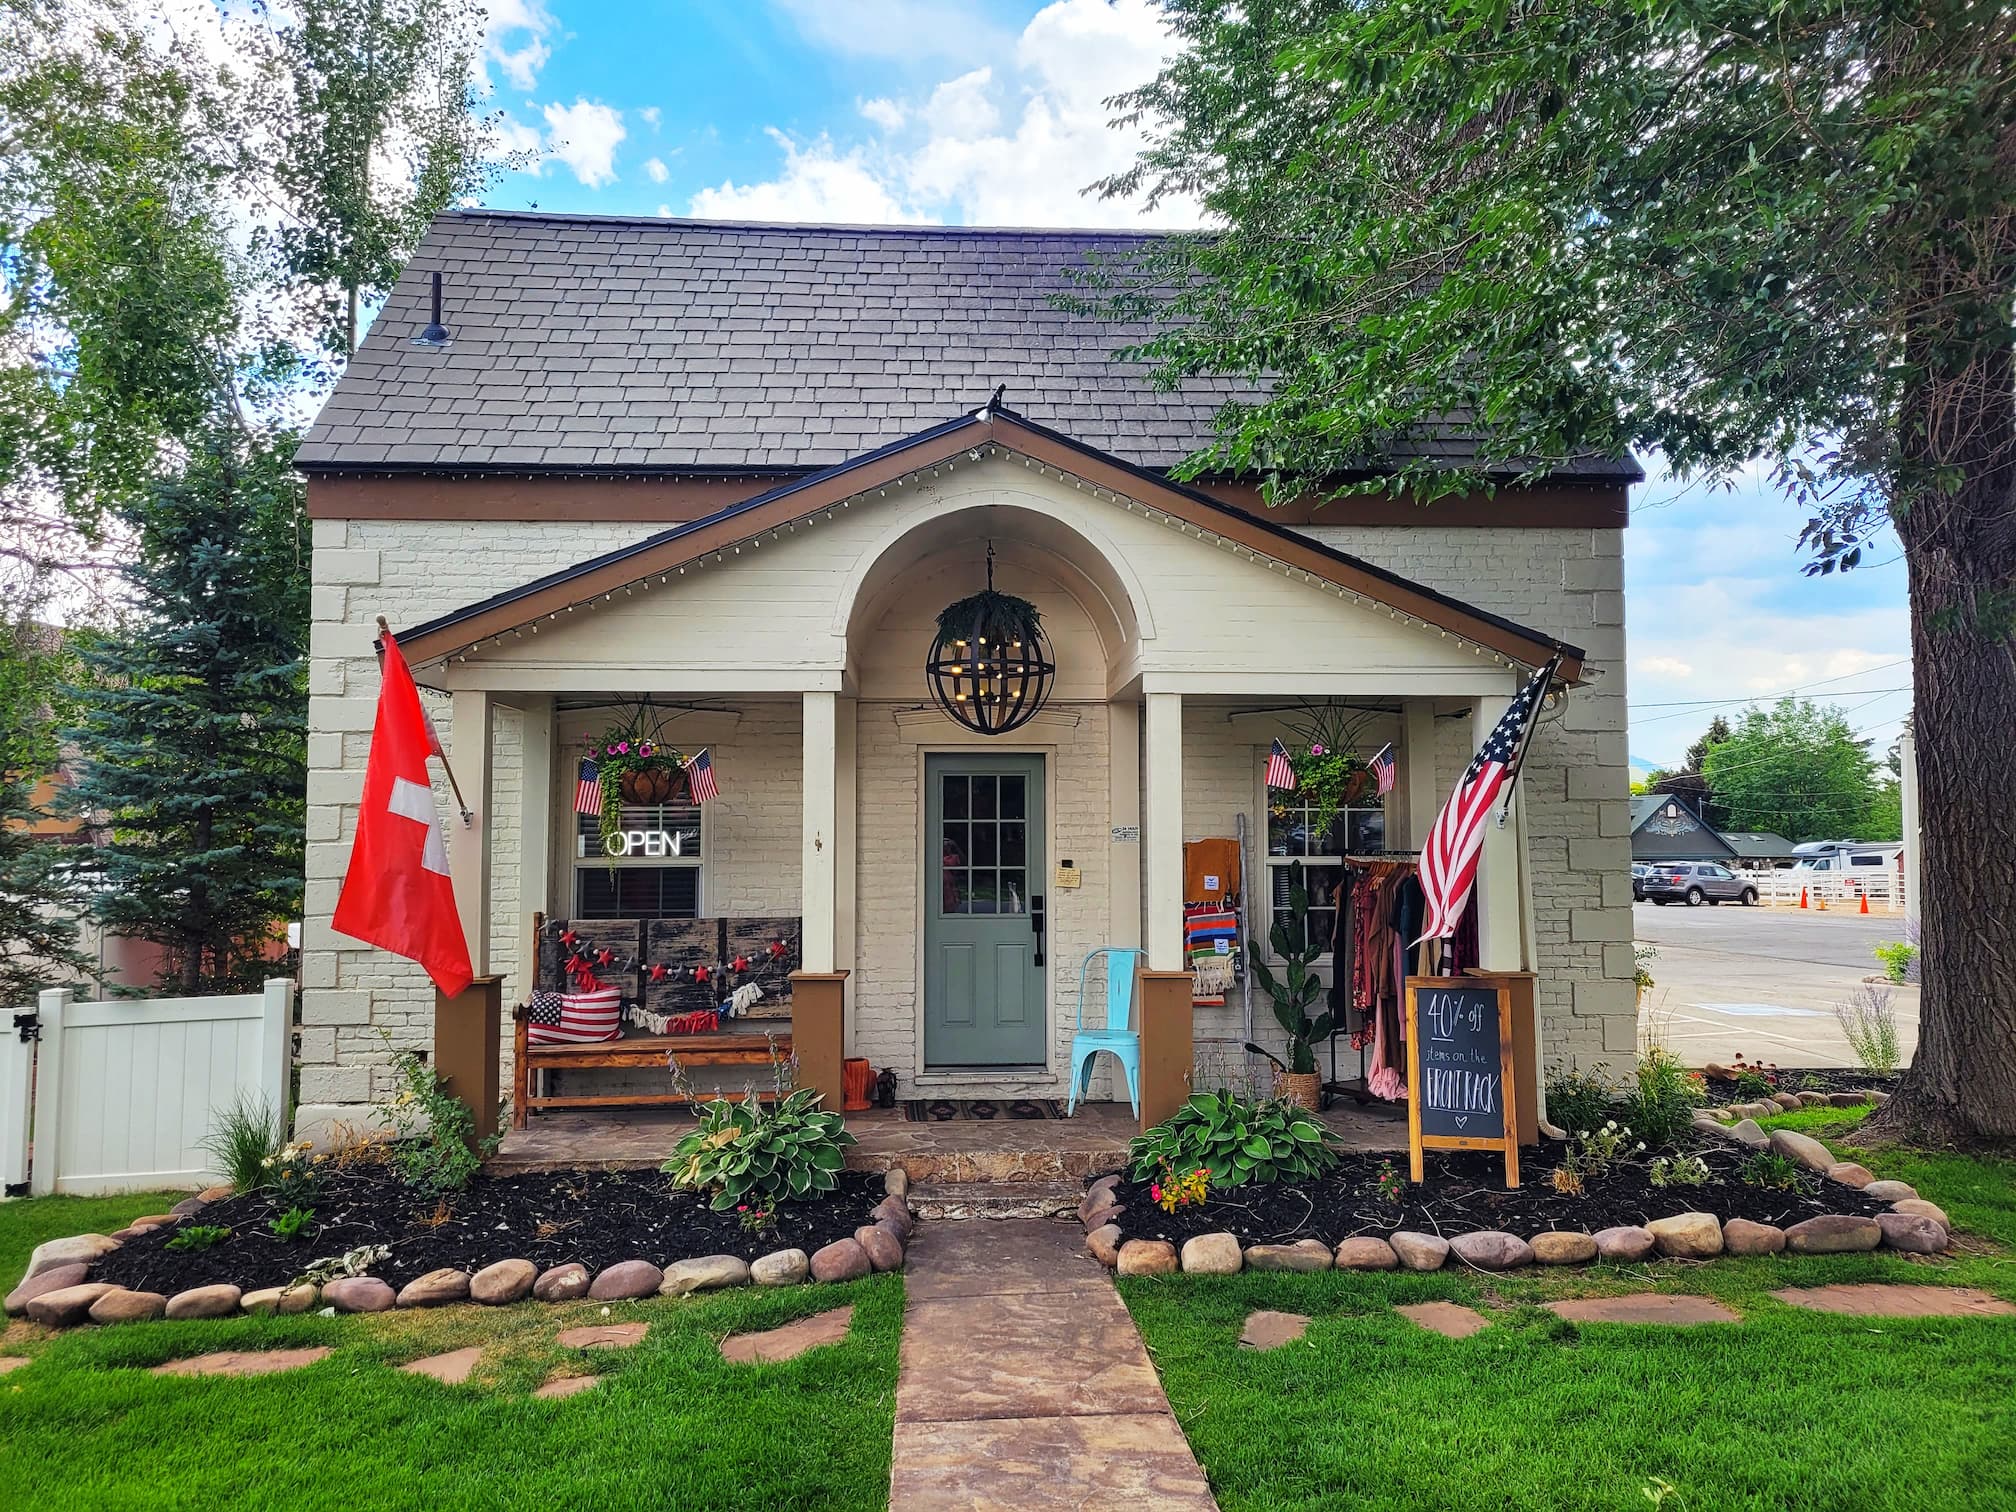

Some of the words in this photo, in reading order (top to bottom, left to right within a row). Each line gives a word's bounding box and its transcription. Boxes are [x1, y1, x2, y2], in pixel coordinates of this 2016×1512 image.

[606, 831, 680, 856] OPEN
[1428, 993, 1464, 1037] 40%
[1469, 1003, 1485, 1032] off
[1426, 1045, 1451, 1062] items
[1452, 1052, 1467, 1062] on
[1471, 1048, 1488, 1064] the
[1427, 1067, 1462, 1109] FRONT
[1464, 1071, 1499, 1114] RACK
